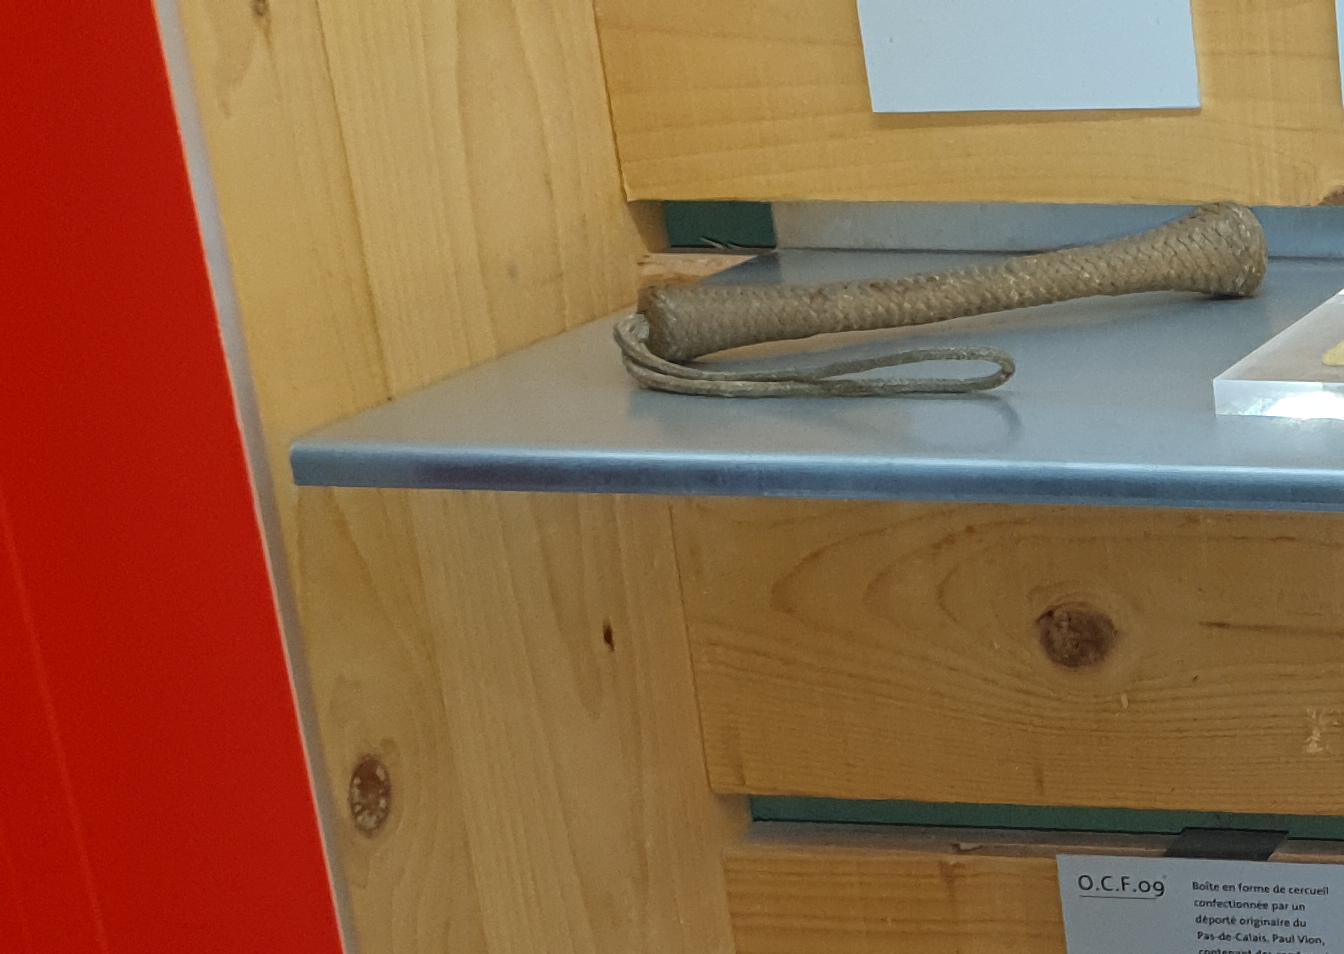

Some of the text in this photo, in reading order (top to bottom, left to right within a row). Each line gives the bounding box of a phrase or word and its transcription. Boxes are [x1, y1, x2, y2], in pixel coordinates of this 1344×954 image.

[1078, 875, 1166, 897] O.C.F.09
[1192, 882, 1220, 892] Boîte
[1238, 883, 1270, 894] forme
[1273, 885, 1286, 894] de
[1289, 887, 1329, 896] cercueil
[1194, 899, 1269, 910] confectionnée
[1272, 903, 1289, 913] par
[1195, 915, 1307, 929] déporté originaire du
[1272, 934, 1295, 944] Paul
